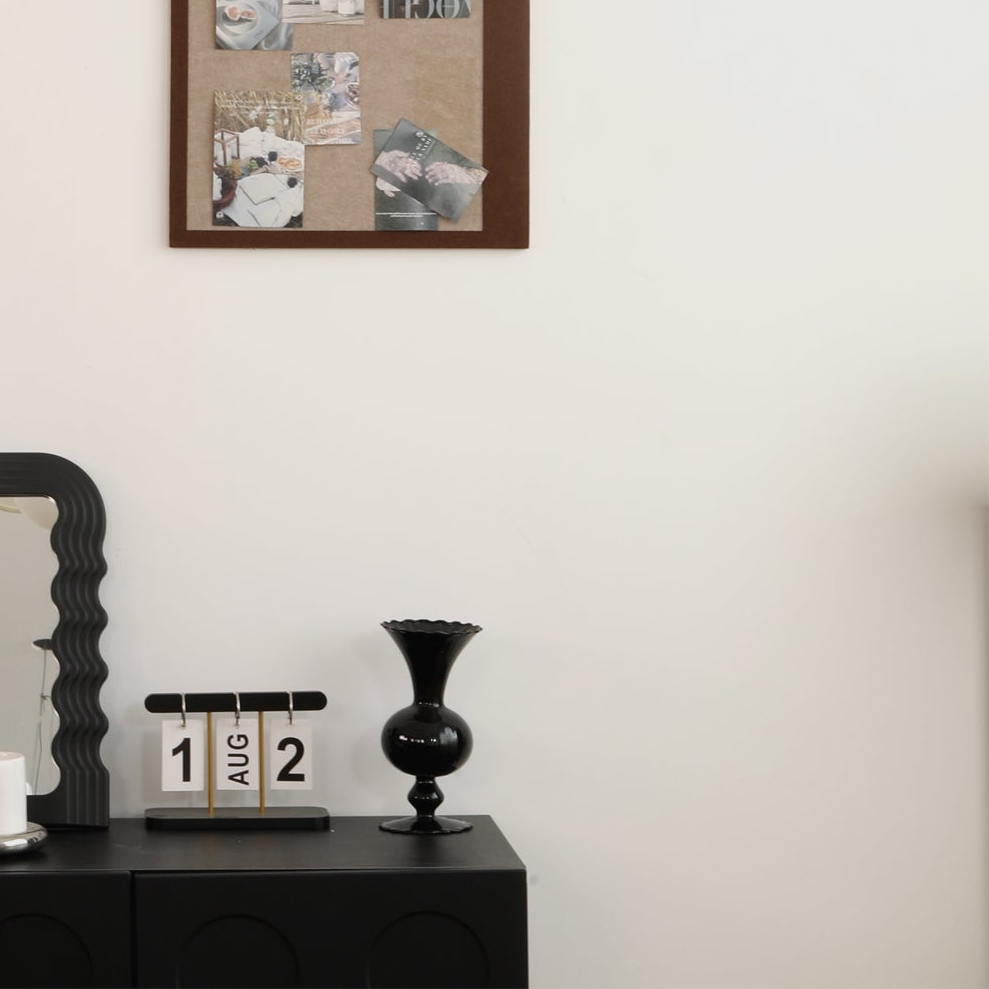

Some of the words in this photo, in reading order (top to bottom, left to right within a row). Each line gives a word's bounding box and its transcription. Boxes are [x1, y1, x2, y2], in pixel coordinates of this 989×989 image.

[172, 738, 191, 782] 1
[227, 734, 250, 786] AUG
[277, 737, 306, 782] 2
